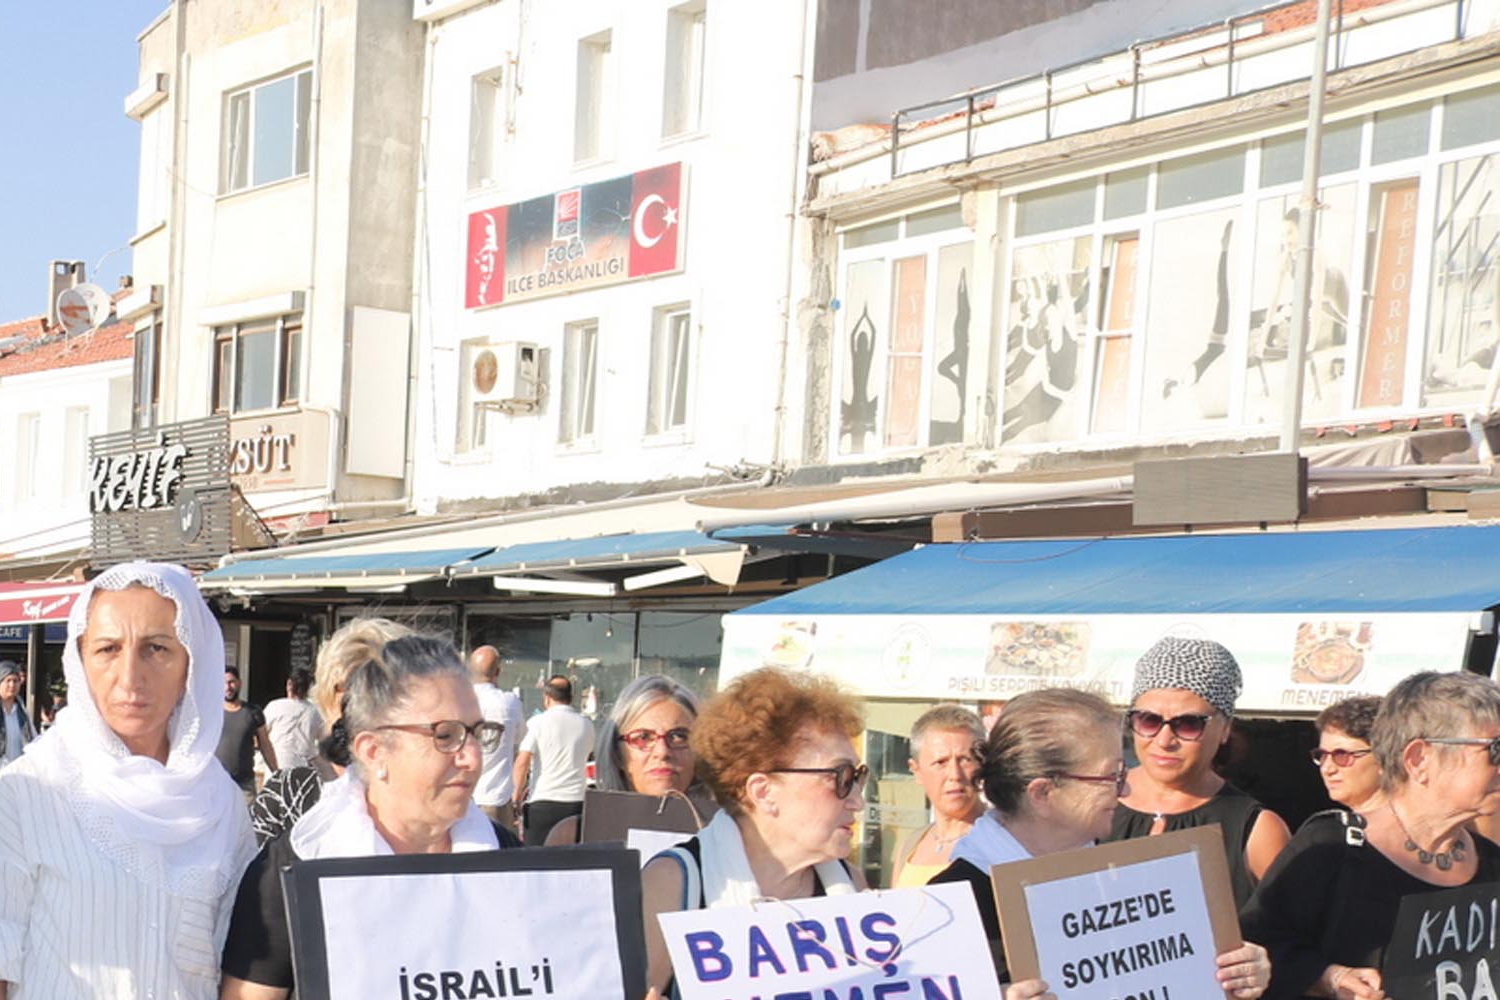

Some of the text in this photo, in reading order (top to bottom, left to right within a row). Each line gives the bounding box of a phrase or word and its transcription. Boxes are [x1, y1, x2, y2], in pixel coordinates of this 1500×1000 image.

[1061, 889, 1176, 938] GAZZE'DE
[684, 912, 902, 982] BARIŞ
[1061, 932, 1195, 989] SOYKIRIMA
